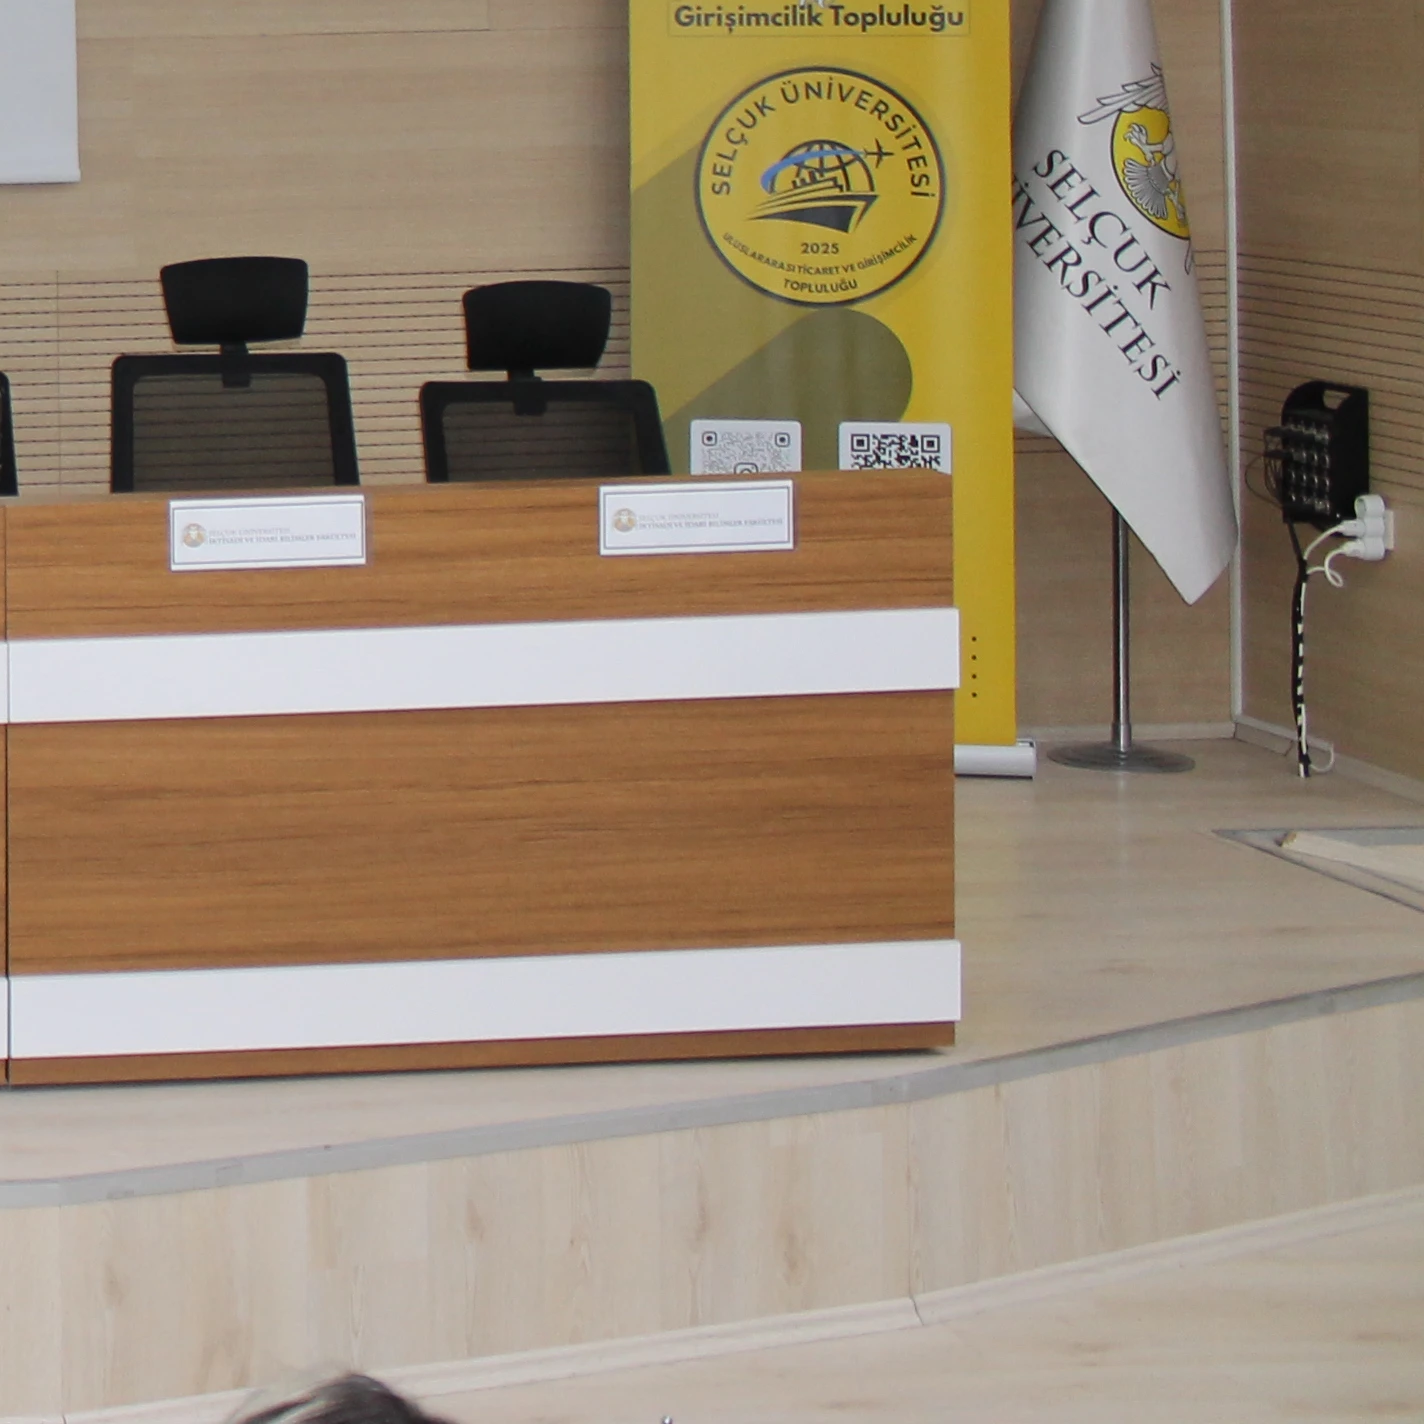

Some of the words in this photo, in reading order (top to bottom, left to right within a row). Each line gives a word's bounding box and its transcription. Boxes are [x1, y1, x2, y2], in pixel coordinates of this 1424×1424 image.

[674, 4, 822, 34] Girişimcilik
[829, 4, 964, 32] Topluluğu
[711, 96, 776, 195] SELÇUK
[780, 77, 935, 198] ÜNİVERSİTESİ
[1032, 149, 1172, 311] SELÇUK
[800, 242, 840, 255] 2025
[797, 264, 840, 275] TİCARET
[841, 263, 856, 273] VE
[783, 277, 858, 293] TOPLULUĞU
